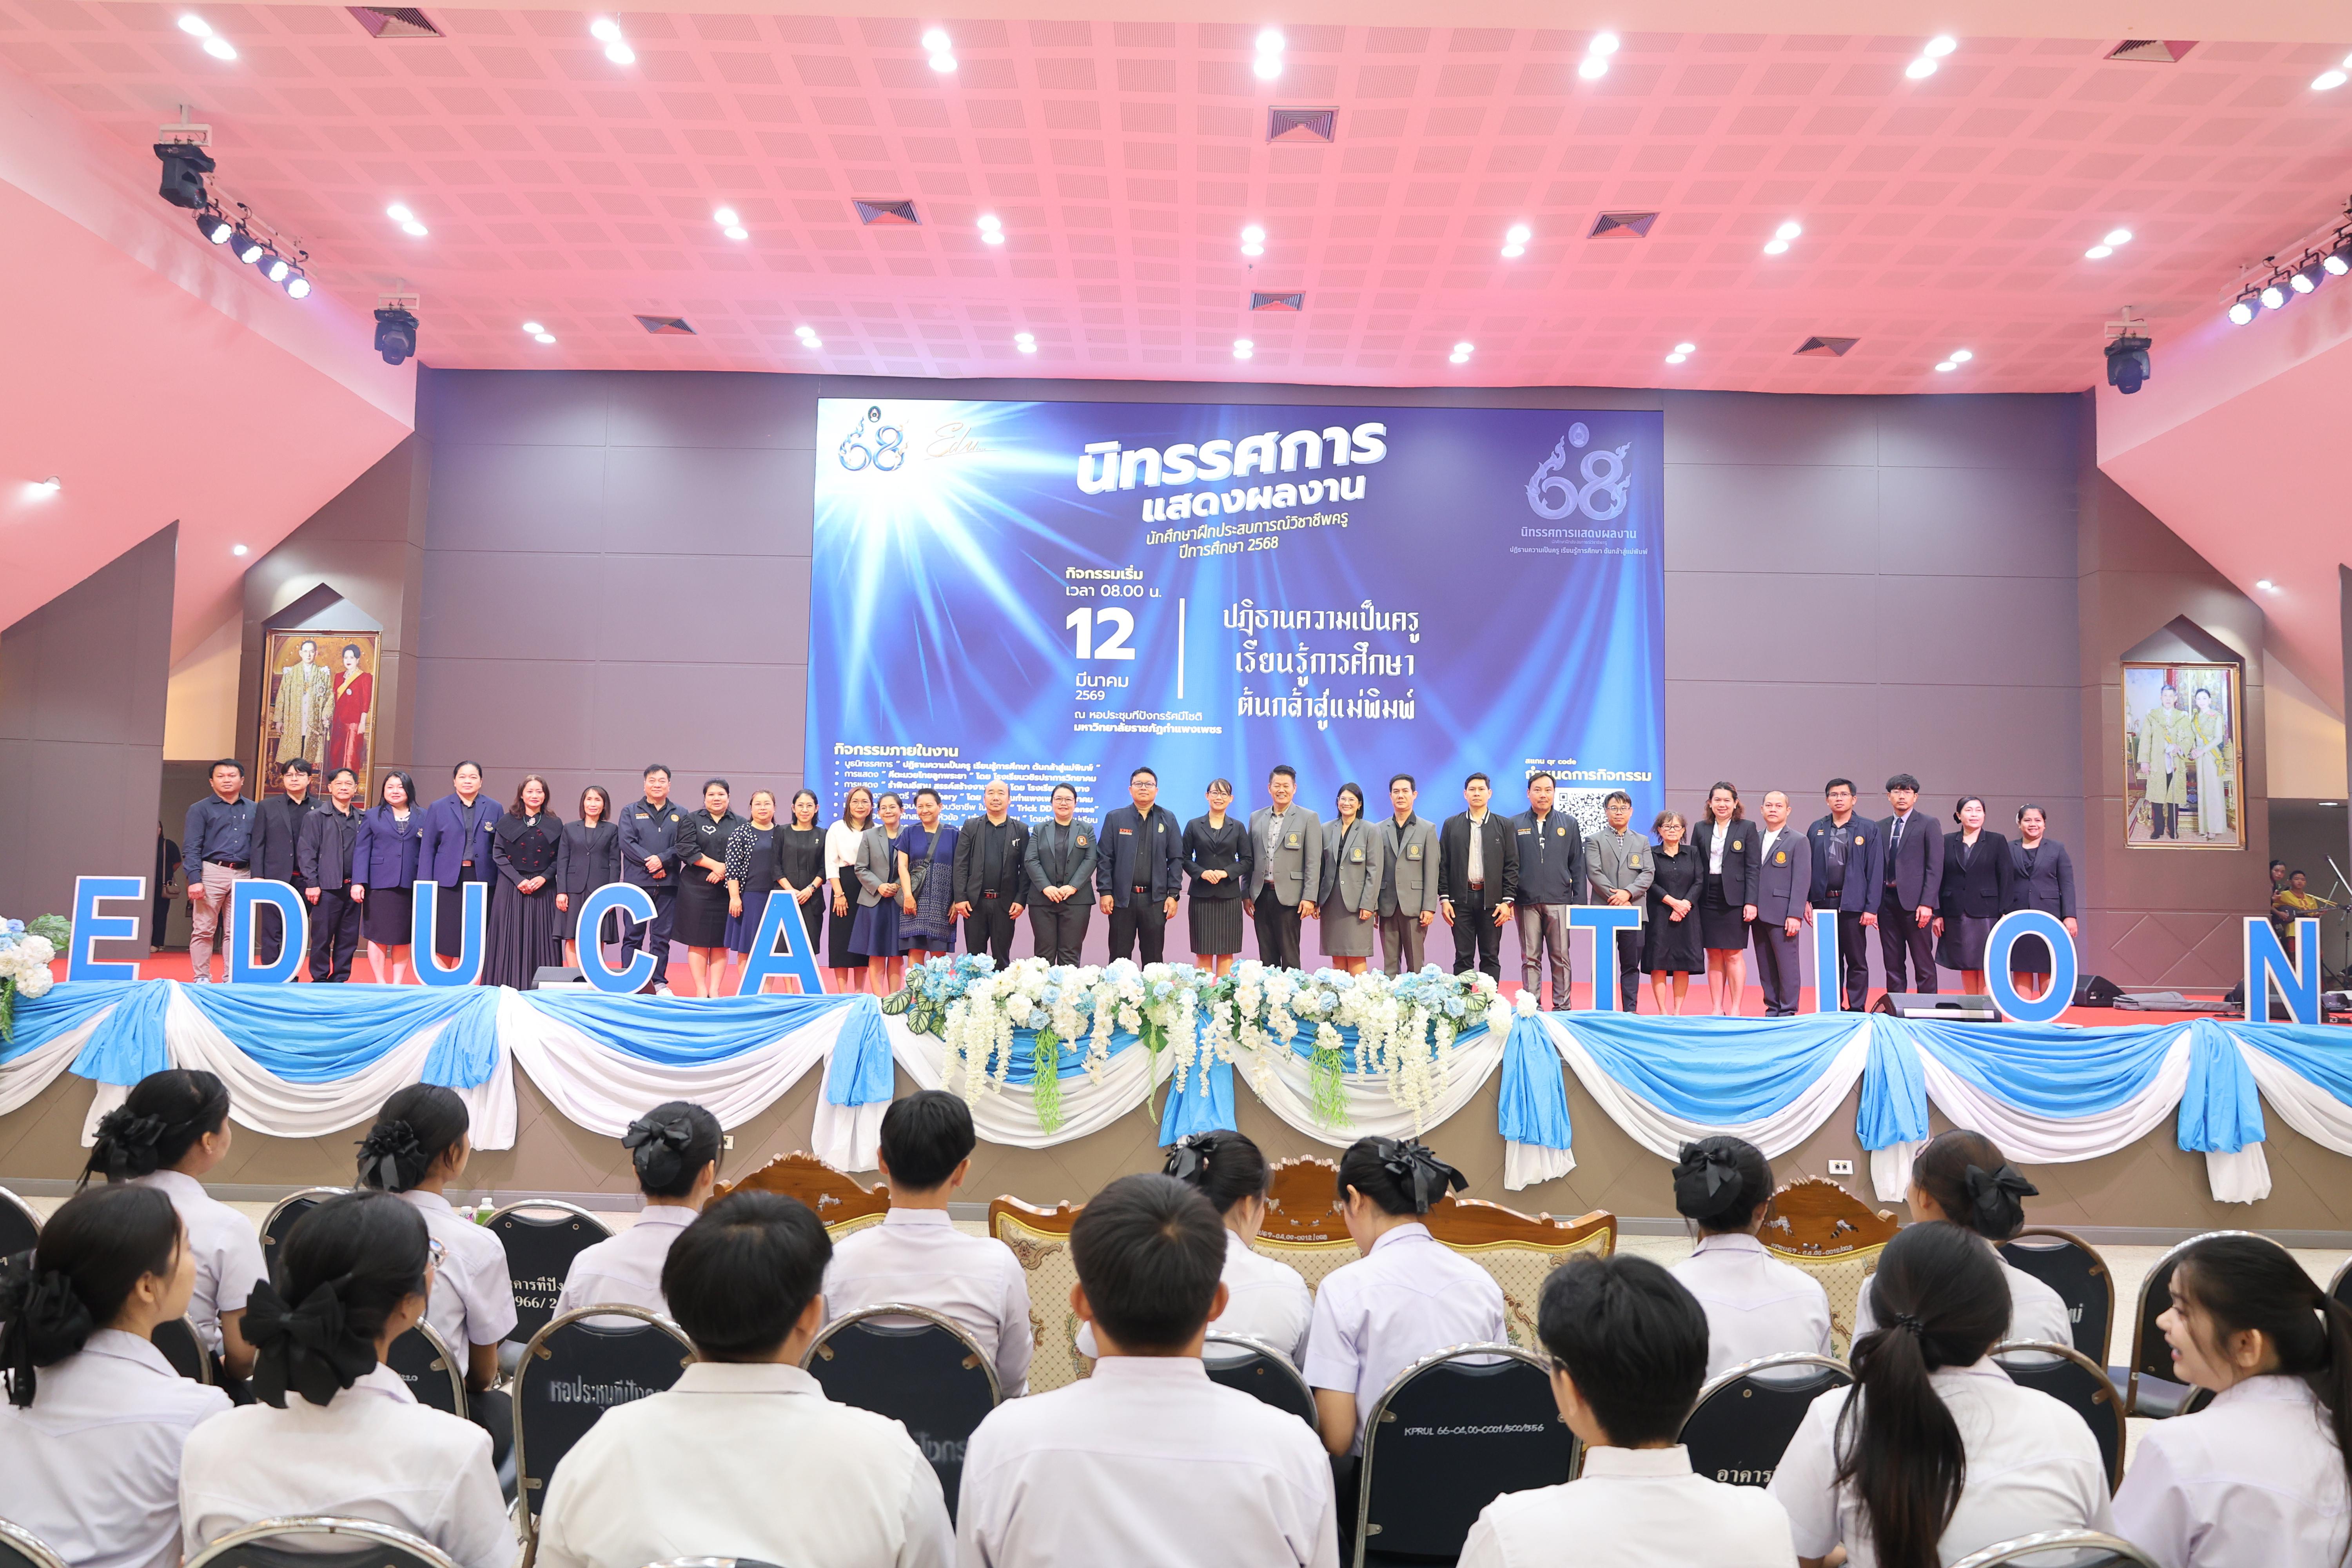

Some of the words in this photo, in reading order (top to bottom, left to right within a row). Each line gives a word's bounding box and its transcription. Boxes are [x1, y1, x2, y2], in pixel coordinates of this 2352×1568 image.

[1076, 422, 1387, 495] นิทรรศการ
[1142, 473, 1366, 523] แสดงผลงาน
[1146, 511, 1349, 545] นักศึกษาฝึกประสบการณ์วิชาชีพครู
[1521, 526, 1637, 539] นิทรรศการแสดงผลงาน
[1179, 541, 1244, 559] ปีการศึกษา
[1247, 536, 1279, 552] 2568
[1065, 564, 1143, 580] กิจกรรมเริ่ม
[1066, 586, 1094, 597] เวลา
[1101, 584, 1144, 597] 08.00
[1149, 588, 1162, 597] น.
[1066, 607, 1135, 660] 12
[1236, 639, 1414, 688] เรียนรู้การศึกษา
[1075, 671, 1129, 689] มีนาคม
[1075, 690, 1105, 701] 2569
[1089, 710, 1203, 722] หอประชุมทีปังกรรัศมีโชติ
[1237, 686, 1416, 731] ต้นกล้าสู่แม่พิมพ์
[834, 742, 959, 757] กิจกรรมภายในงาน
[844, 760, 893, 769] บูธนิทรรศการ
